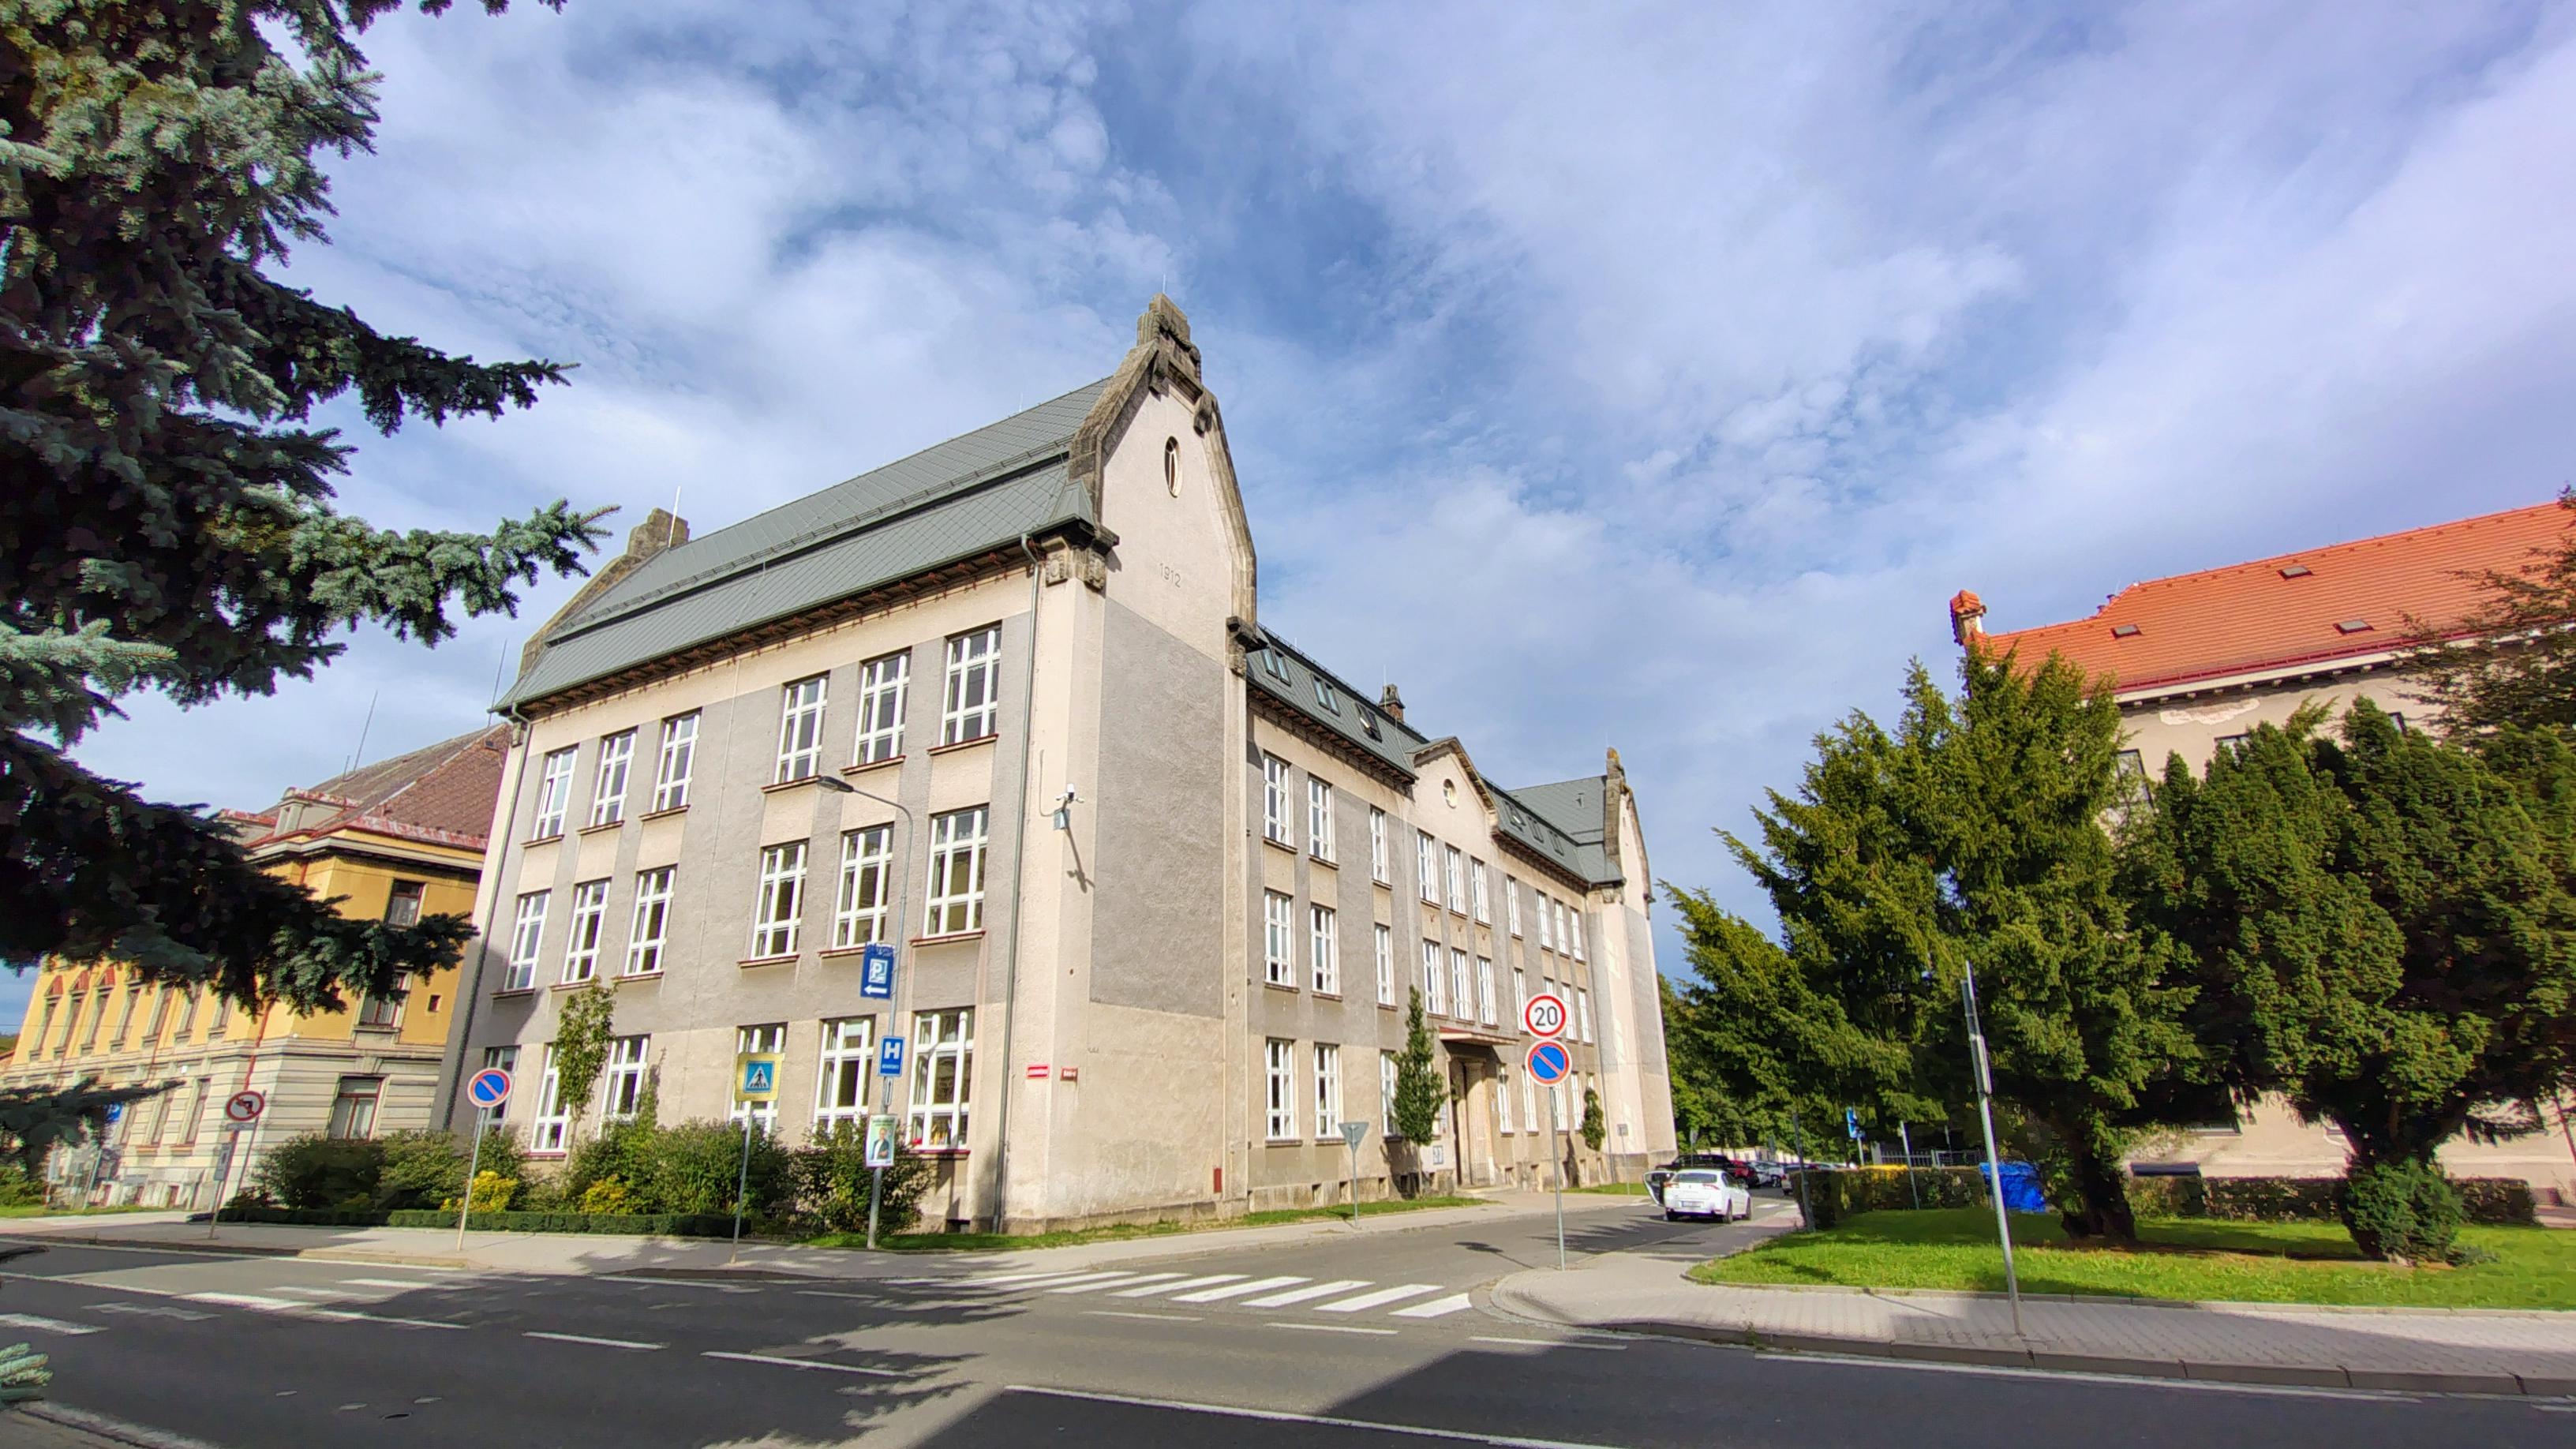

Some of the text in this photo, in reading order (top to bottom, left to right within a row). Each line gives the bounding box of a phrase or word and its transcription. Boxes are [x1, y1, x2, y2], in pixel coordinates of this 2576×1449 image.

[1159, 563, 1181, 588] 1912
[871, 963, 882, 979] P
[1534, 1006, 1558, 1026] 20
[884, 1042, 900, 1059] H
